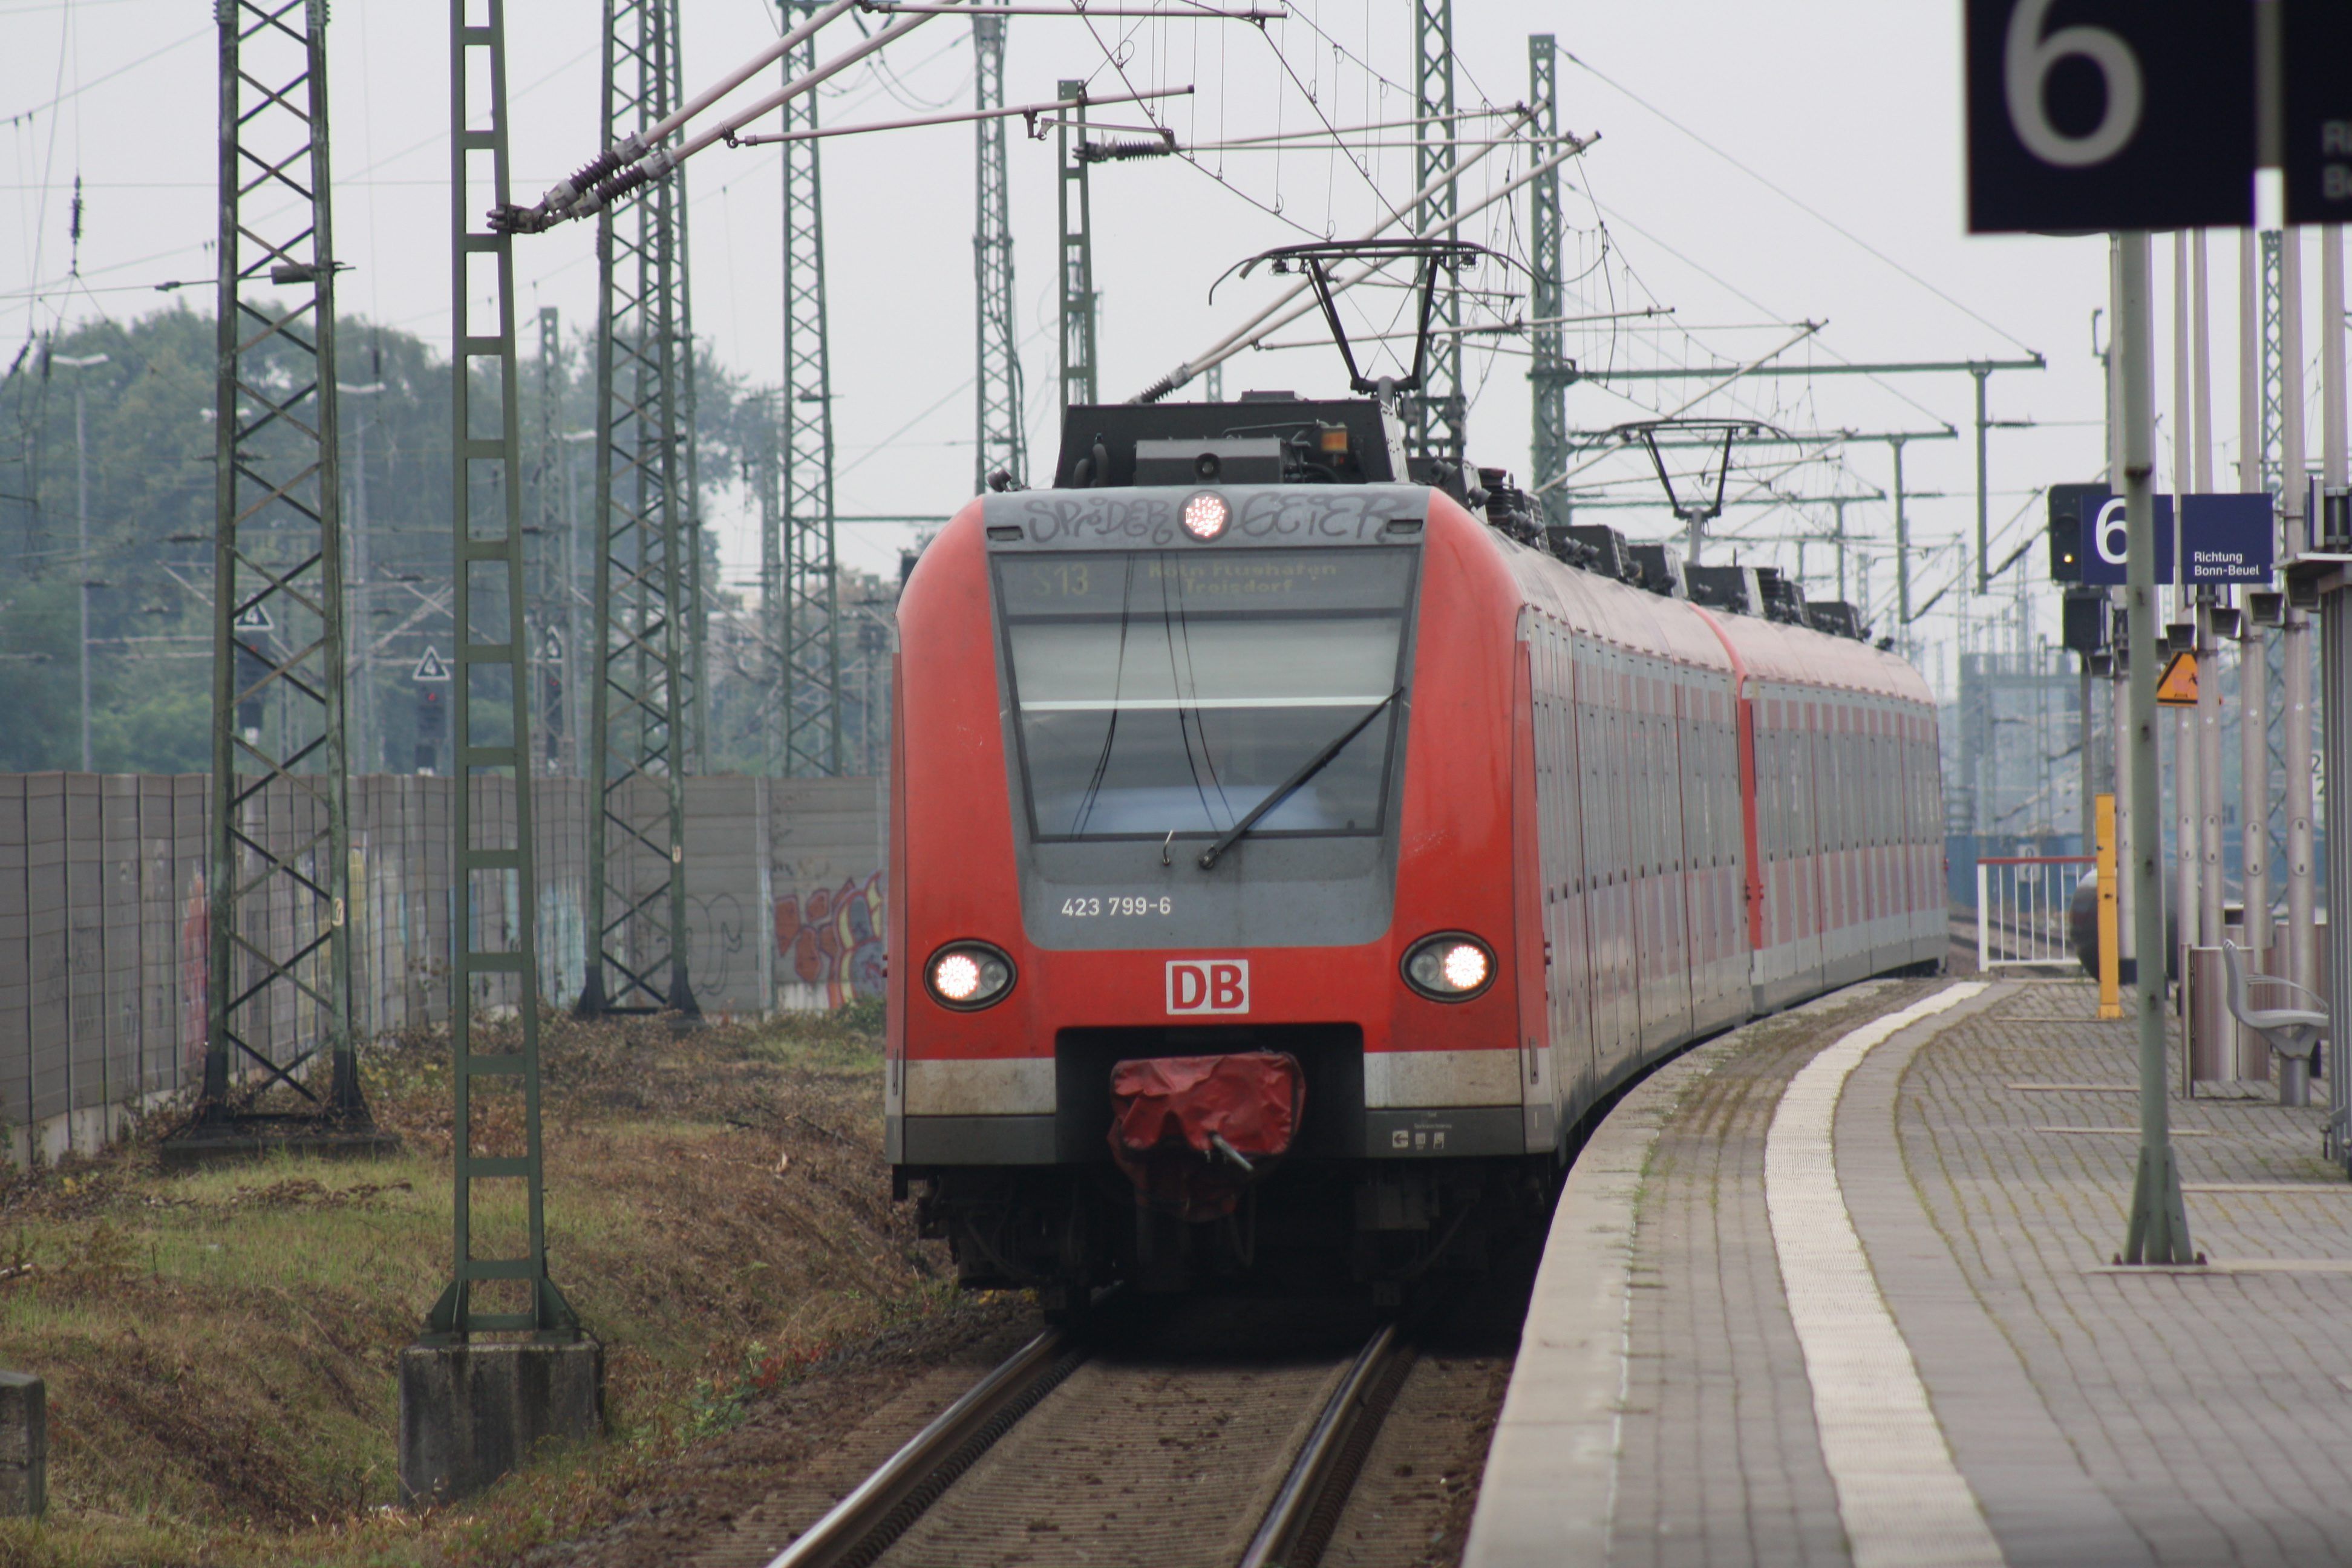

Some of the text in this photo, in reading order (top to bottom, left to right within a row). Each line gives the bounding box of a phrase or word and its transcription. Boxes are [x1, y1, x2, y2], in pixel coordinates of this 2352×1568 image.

[2004, 0, 2144, 167] 6
[2096, 498, 2127, 564] 6
[2194, 551, 2243, 564] Richtung
[2194, 564, 2260, 577] Bonn-Beuel
[1031, 562, 1089, 596] S13
[425, 657, 437, 676] 4
[1061, 896, 1171, 916] 423 799-6
[1172, 964, 1244, 1010] DB
